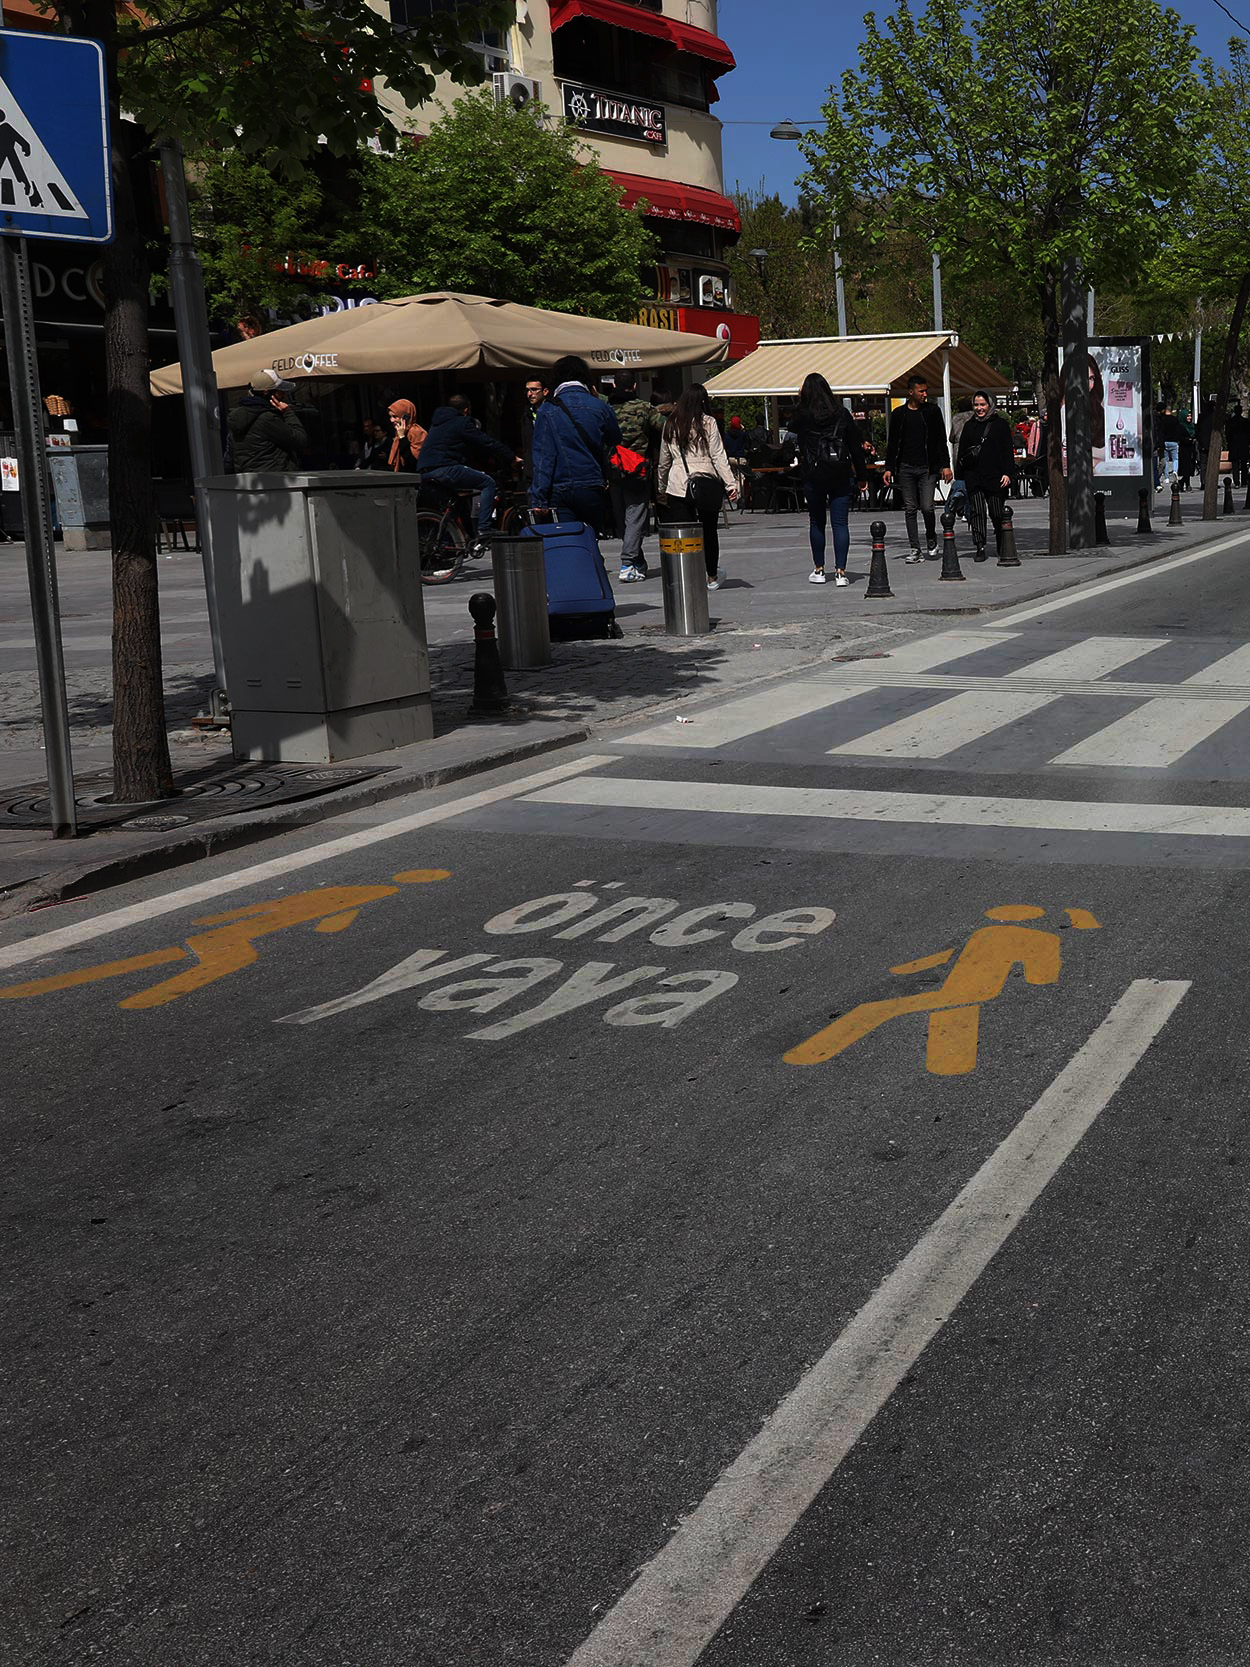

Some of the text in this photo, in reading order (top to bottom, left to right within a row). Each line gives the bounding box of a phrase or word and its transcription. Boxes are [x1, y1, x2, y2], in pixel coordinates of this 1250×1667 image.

[590, 93, 663, 130] TITANIC
[629, 308, 676, 331] RASI
[483, 880, 837, 953] önce
[271, 948, 739, 1041] yaya
